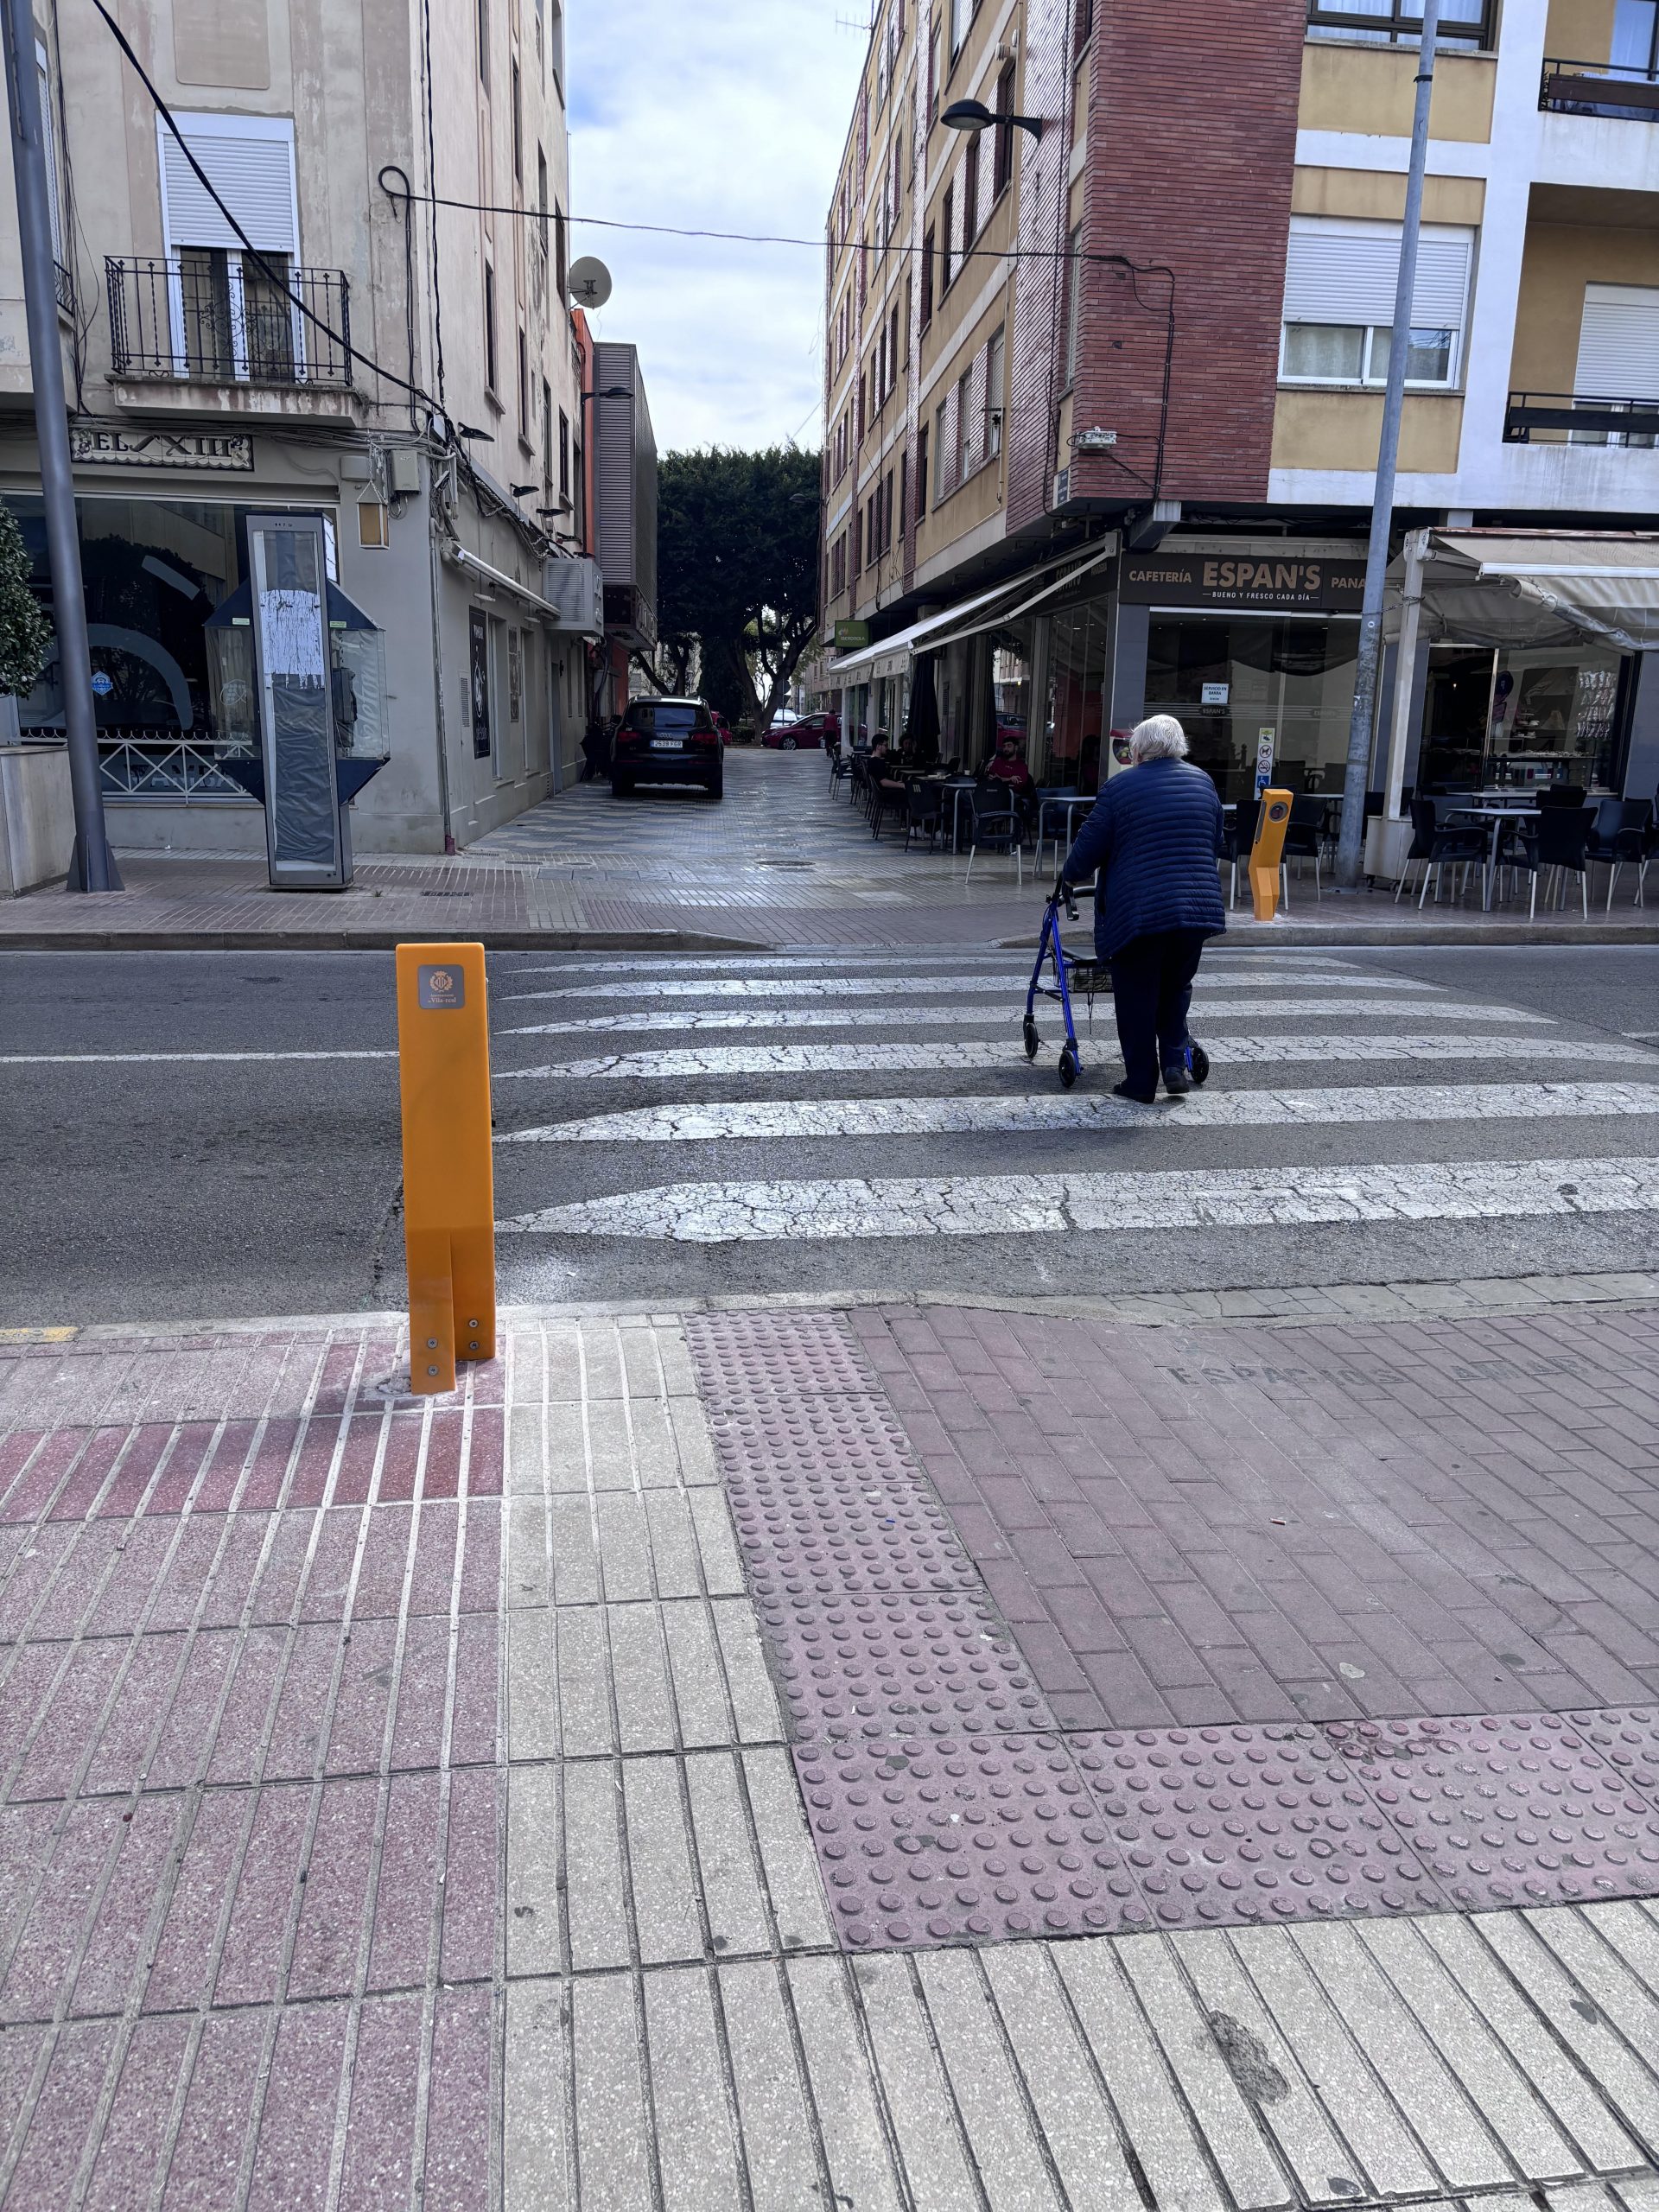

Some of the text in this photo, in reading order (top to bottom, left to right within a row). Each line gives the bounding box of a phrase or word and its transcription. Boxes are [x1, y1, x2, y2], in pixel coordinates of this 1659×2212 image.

[1128, 561, 1367, 590] CAFETERÍA ESPAN'S PANA
